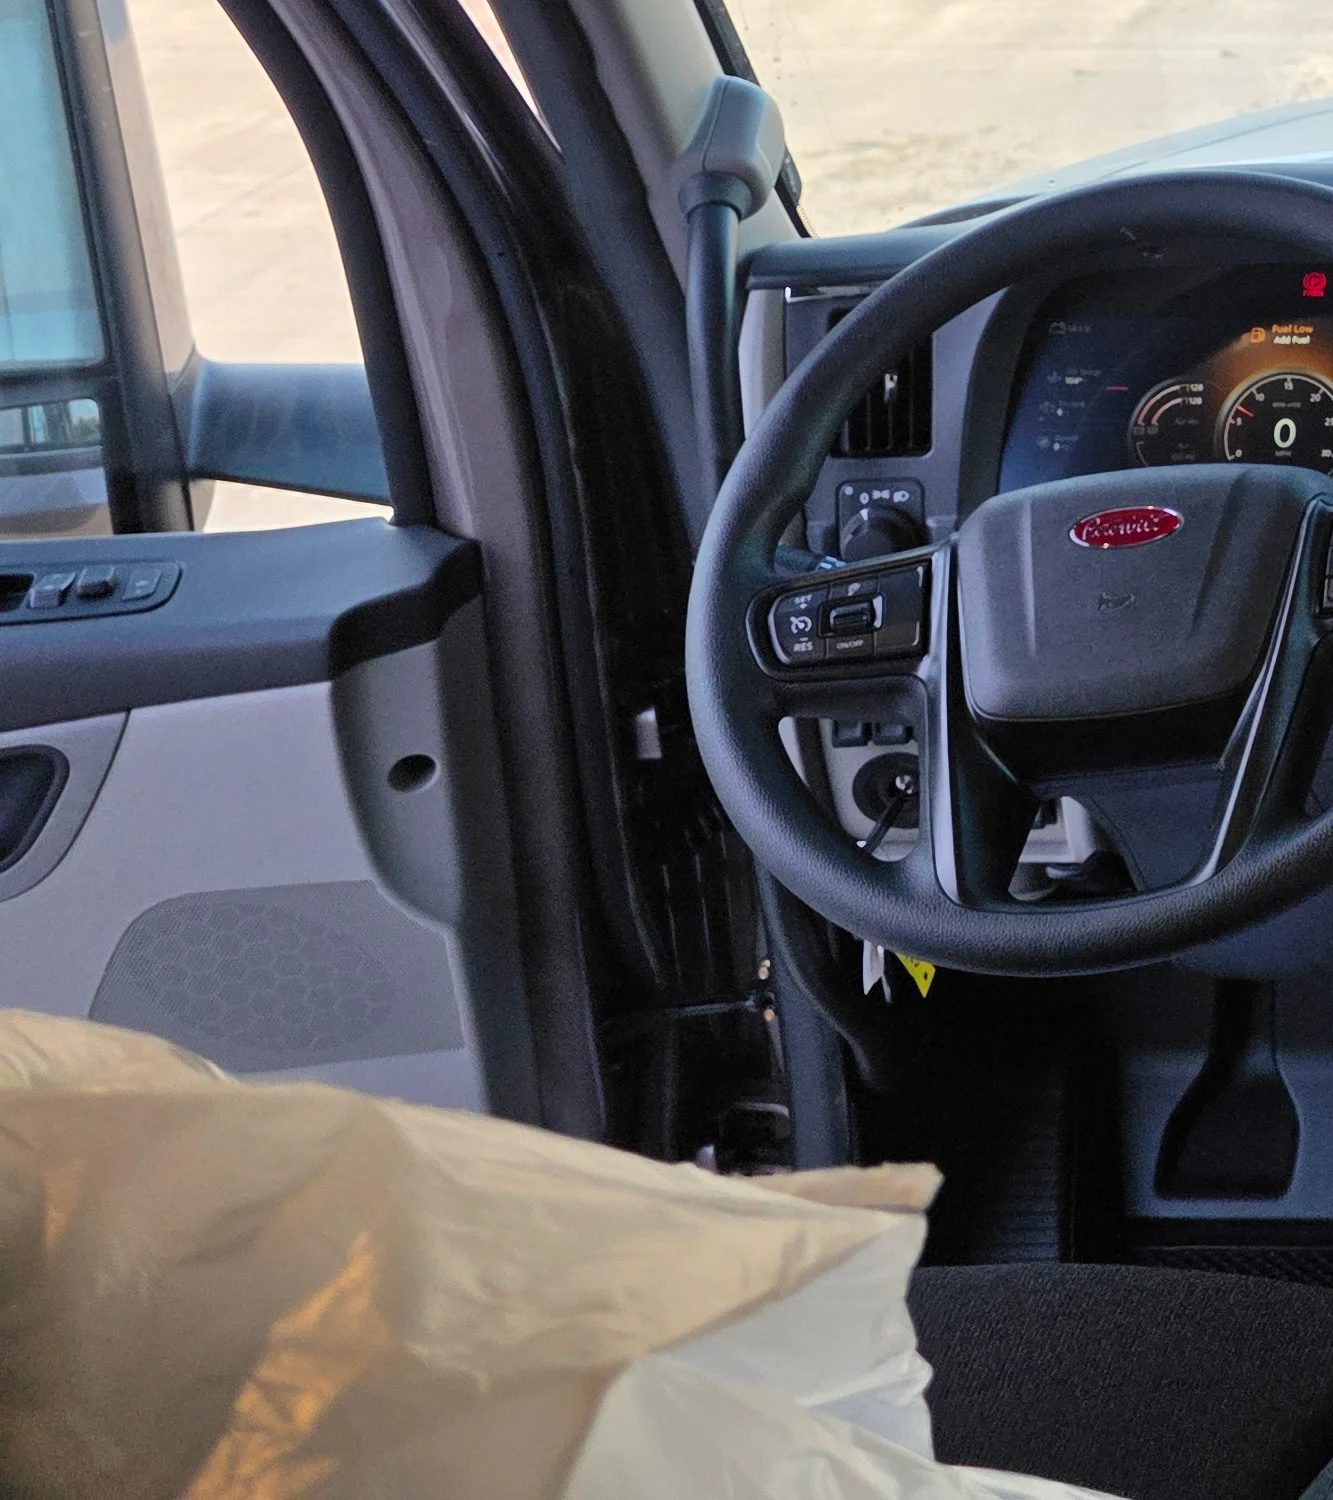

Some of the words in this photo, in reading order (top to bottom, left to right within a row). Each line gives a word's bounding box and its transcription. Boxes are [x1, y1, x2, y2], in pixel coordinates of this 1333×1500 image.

[1271, 324, 1292, 334] Fuel
[1293, 324, 1315, 334] Low
[1273, 418, 1297, 448] 0
[793, 641, 813, 652] RES
